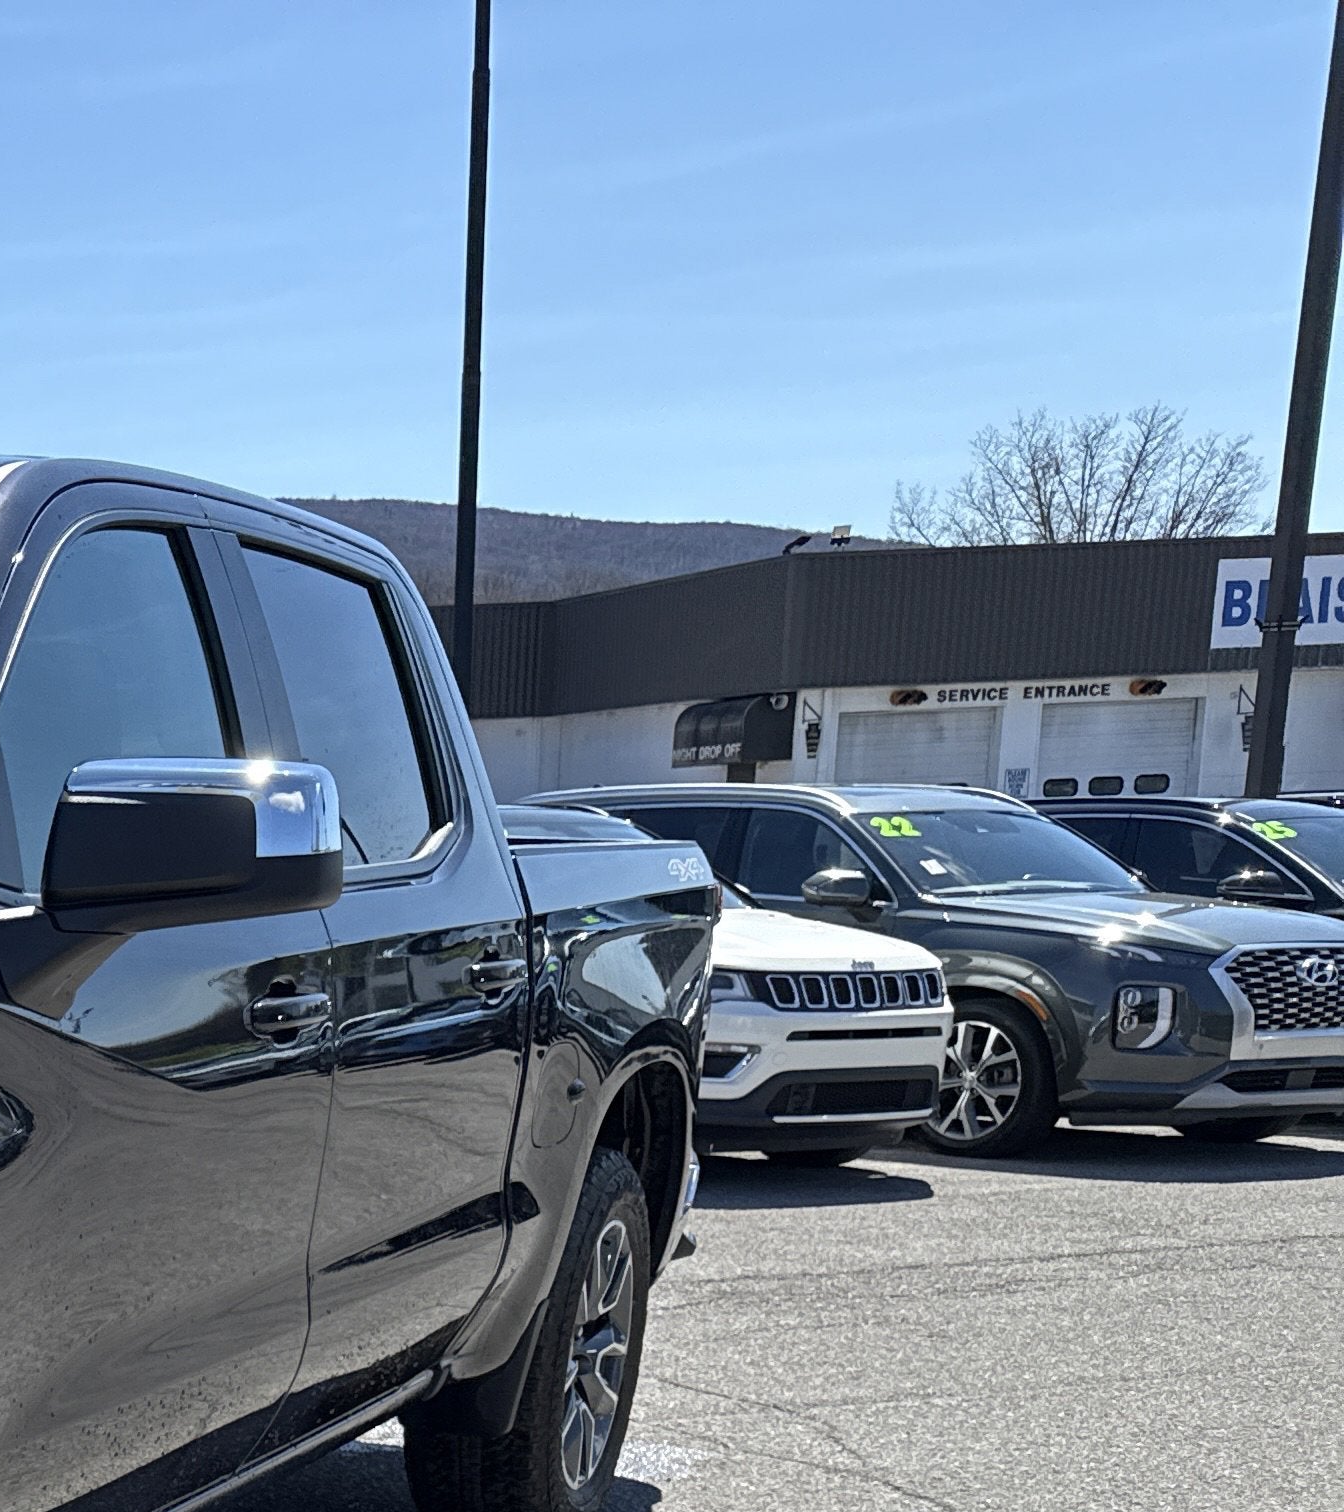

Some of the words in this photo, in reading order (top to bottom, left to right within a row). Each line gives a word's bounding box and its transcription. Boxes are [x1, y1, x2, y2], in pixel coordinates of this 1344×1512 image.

[936, 687, 1010, 704] SERVICE
[1022, 683, 1112, 700] ENTRANCE
[698, 744, 723, 760] DROP
[723, 742, 743, 758] OFF
[869, 816, 923, 837] 22
[1252, 820, 1298, 840] 25
[667, 857, 705, 882] 4X4
